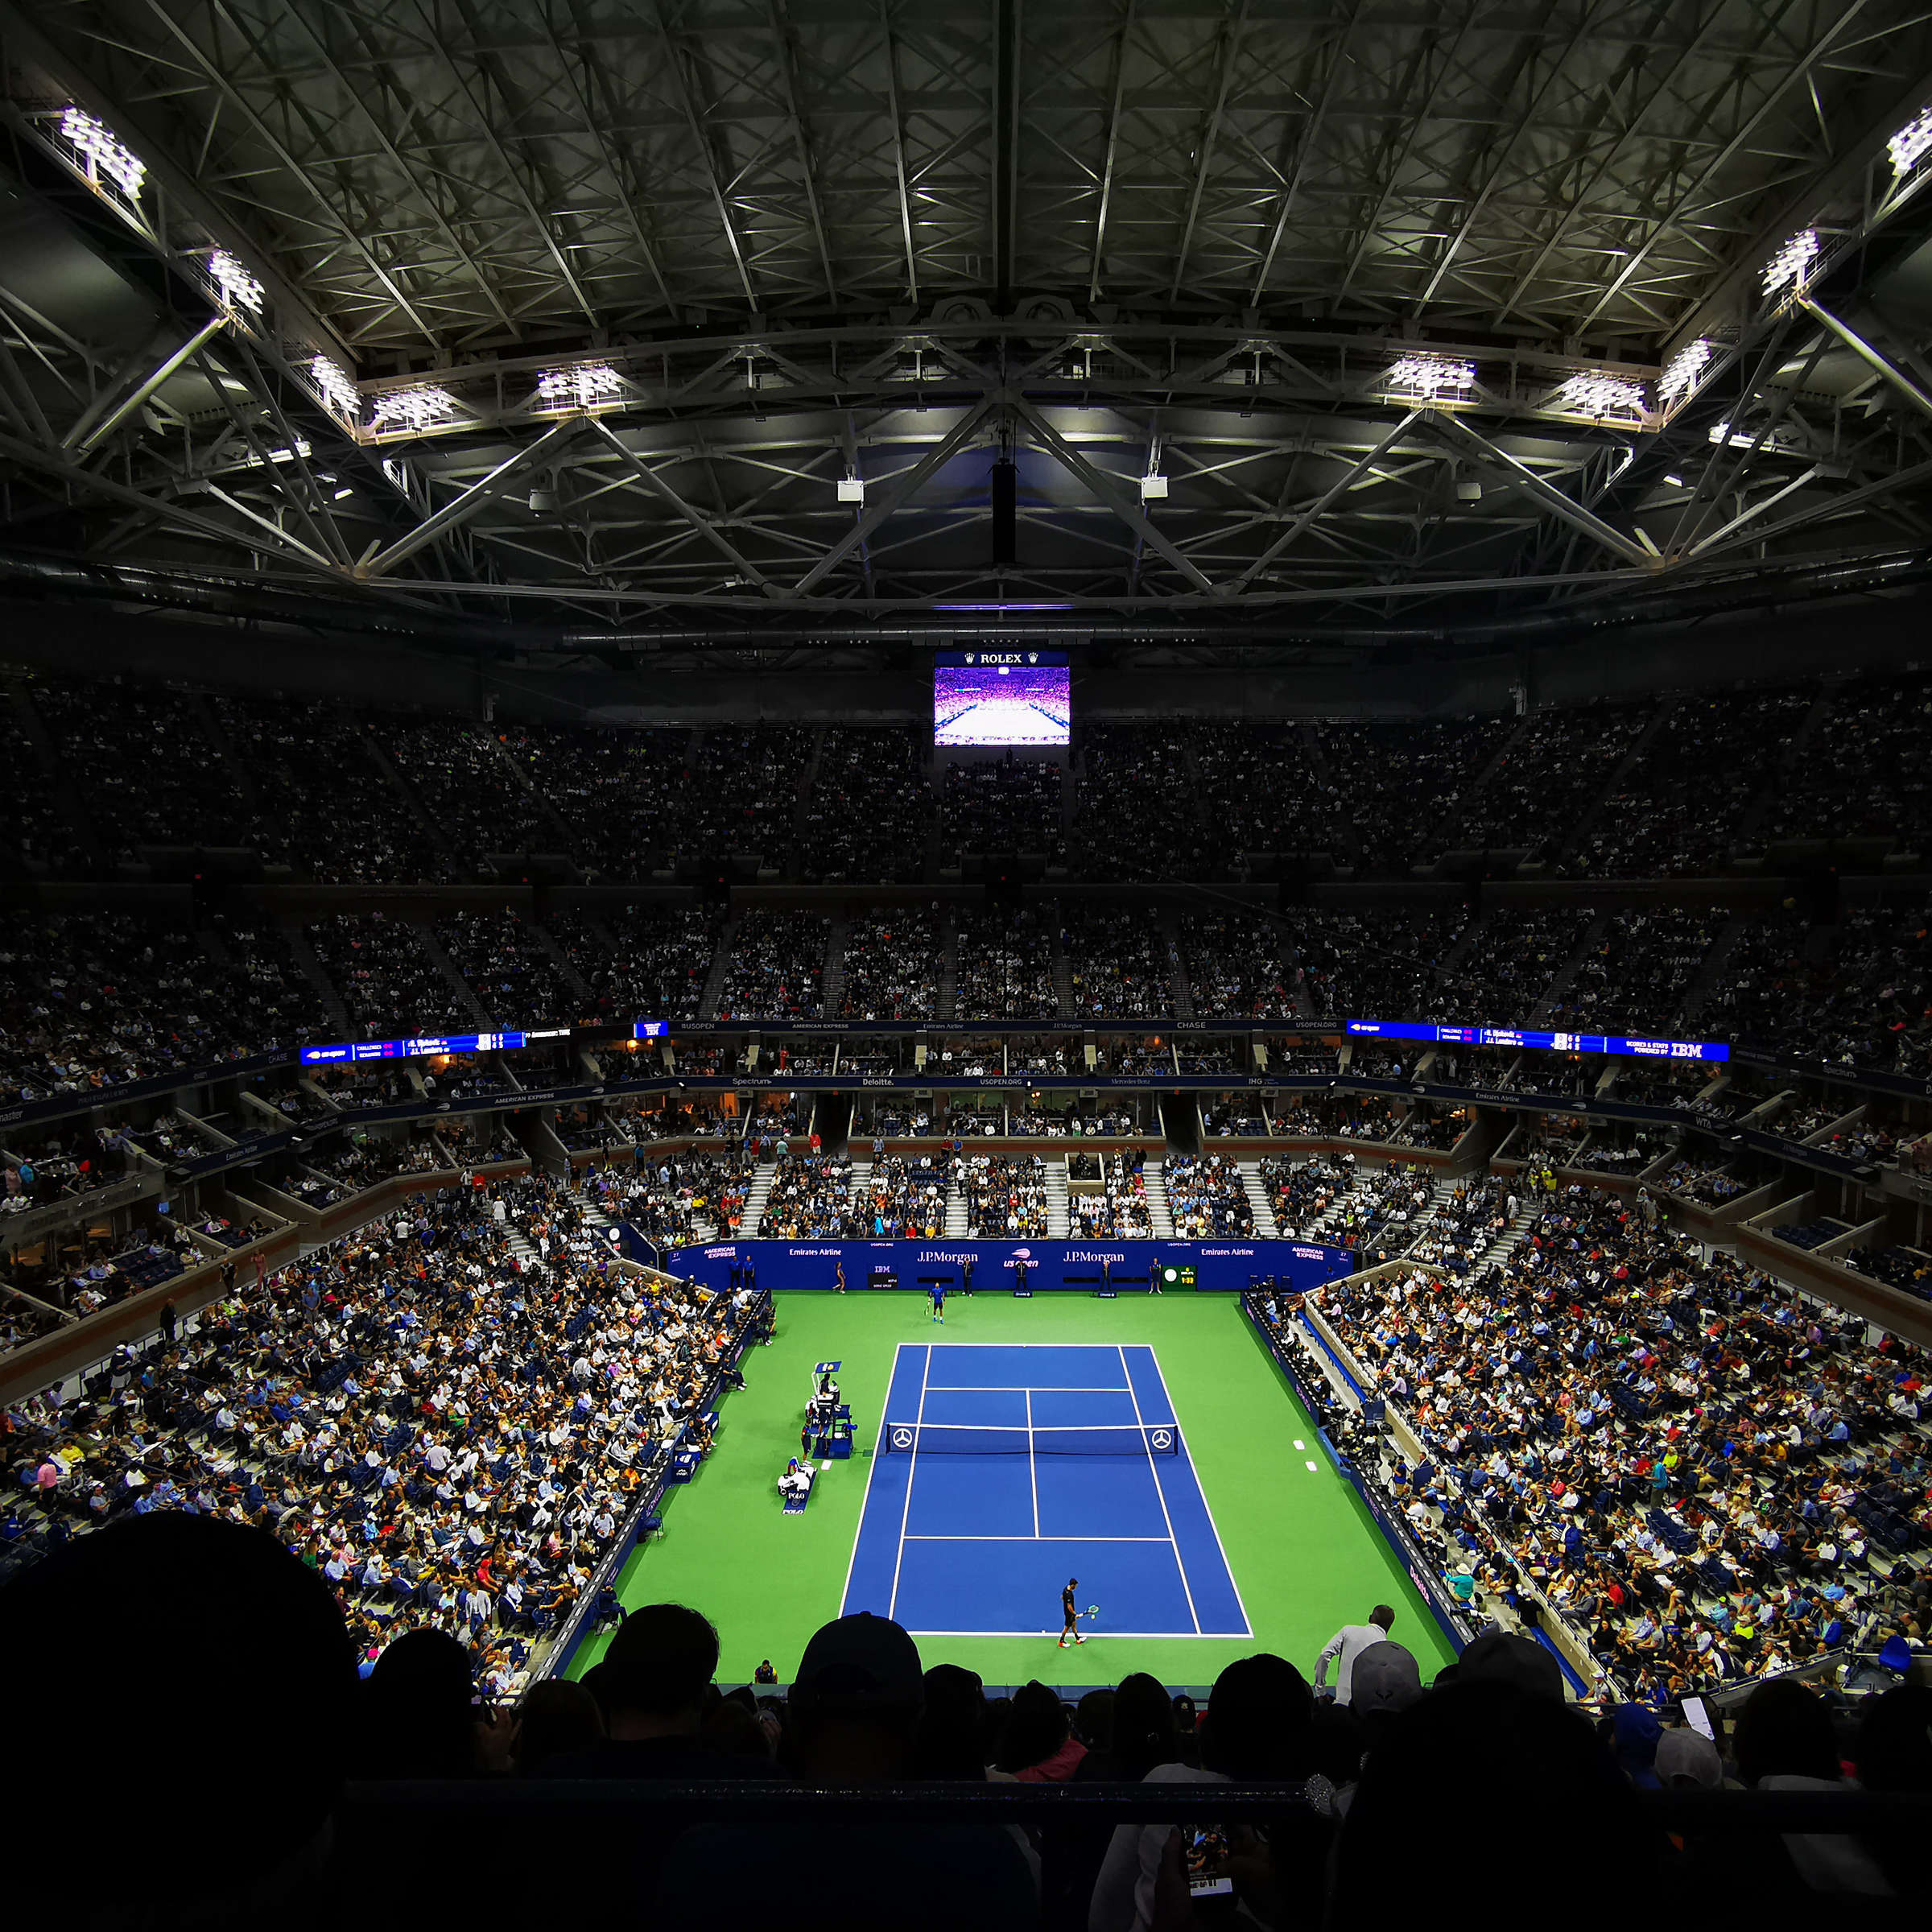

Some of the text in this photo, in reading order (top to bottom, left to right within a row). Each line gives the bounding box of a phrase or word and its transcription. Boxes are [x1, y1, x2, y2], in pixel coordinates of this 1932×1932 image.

[980, 654, 1022, 663] ROLEX
[1671, 1043, 1703, 1058] IBM
[733, 1078, 770, 1086] Spectrum
[862, 1078, 894, 1086] Deloitte.
[1695, 1116, 1713, 1129] WTA
[704, 1246, 736, 1255] AMERICAN
[1292, 1246, 1324, 1256] AMERICAN
[917, 1251, 979, 1265] J.P.Morgan
[1063, 1251, 1125, 1265] J.P.Morgan
[1296, 1252, 1324, 1261] EXPRESS
[874, 1265, 890, 1274] IBM
